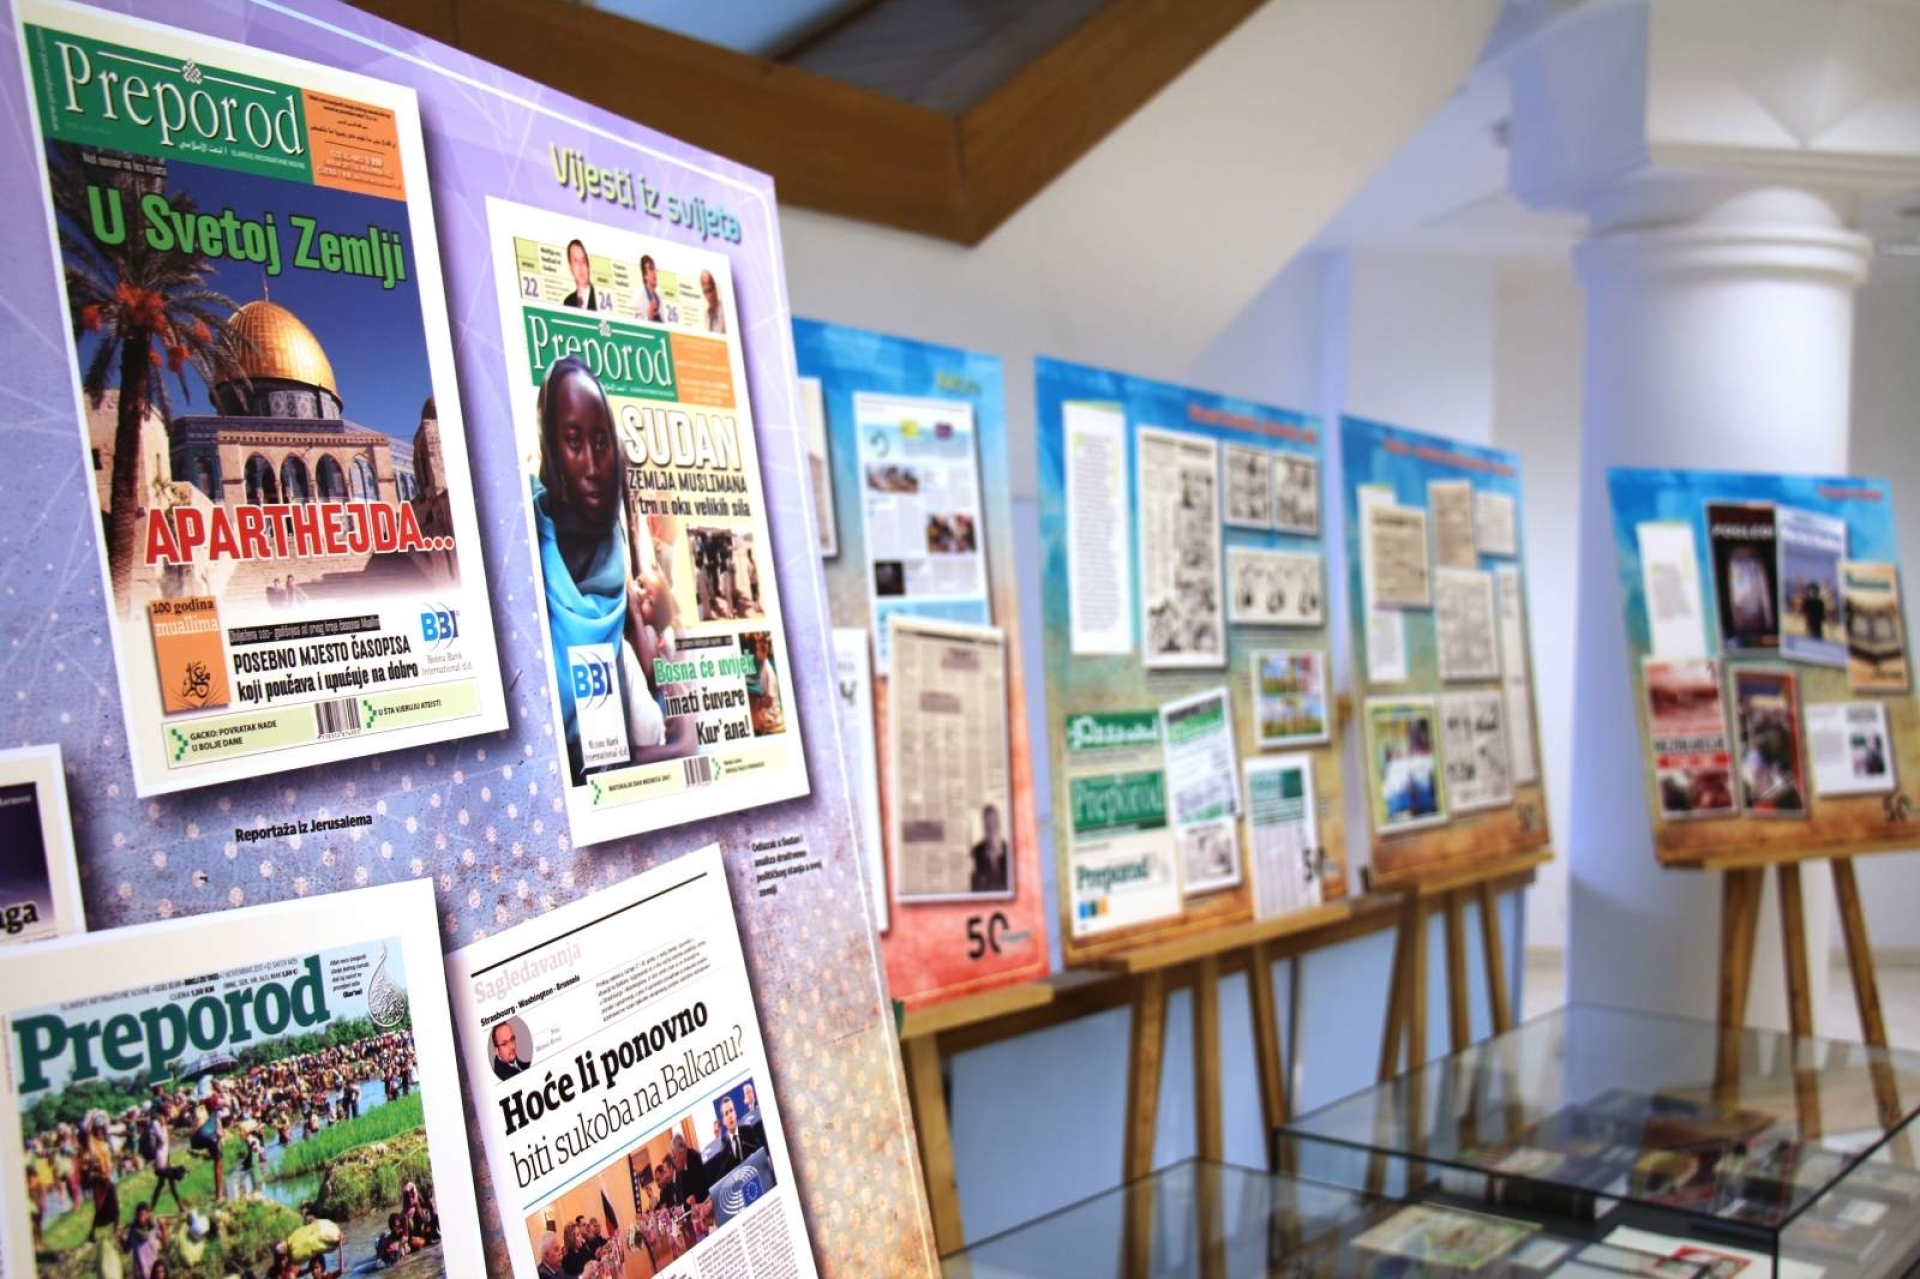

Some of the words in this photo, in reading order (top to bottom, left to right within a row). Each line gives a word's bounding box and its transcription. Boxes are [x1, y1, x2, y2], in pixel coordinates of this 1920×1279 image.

[54, 41, 305, 157] Preporod
[550, 143, 636, 211] Vijesti
[639, 175, 661, 219] iz
[666, 194, 743, 244] svijeta
[87, 185, 127, 246] U
[141, 192, 282, 277] Svetoj
[290, 214, 407, 289] Zemlji
[522, 276, 540, 298] 22
[598, 292, 614, 311] 24
[665, 305, 680, 323] 26
[621, 404, 743, 472] SUDAN
[629, 469, 678, 492] ZEMLJA
[677, 472, 749, 494] MUSLIMANA
[638, 496, 659, 516] trn
[660, 500, 669, 515] u
[671, 496, 693, 516] oku
[694, 497, 730, 517] velikih
[731, 498, 752, 517] sila
[144, 501, 456, 566] APARTHEJDA...
[152, 601, 172, 615] 100
[173, 598, 215, 616] godina
[154, 614, 219, 638] muallima
[420, 609, 460, 642] BBI
[233, 646, 297, 675] POSEBNO
[300, 641, 350, 667] MJESTO
[350, 634, 412, 661] ČASOPISA
[653, 657, 698, 686] Bosna
[700, 652, 716, 680] će
[718, 648, 758, 681] uvijek
[236, 679, 263, 705] koji
[265, 673, 317, 702] poučava
[317, 671, 323, 692] i
[324, 665, 370, 692] upućuje
[371, 666, 387, 682] na
[387, 659, 419, 680] dobro
[571, 660, 614, 700] BBI
[378, 708, 384, 716] U
[665, 690, 701, 717] imati
[702, 685, 746, 712] čuvare
[191, 743, 199, 753] U
[198, 739, 223, 752] BOLJE
[222, 736, 243, 748] DANE
[218, 723, 258, 737] POVRATAK
[257, 719, 278, 730] NADE
[234, 822, 297, 843] Reportaža
[310, 814, 374, 833] Jerusalema
[0, 901, 40, 934] ga
[473, 941, 583, 1005] Sagledavanja
[12, 954, 332, 1094] Preporod
[480, 1006, 516, 1027] Strasbourg
[517, 987, 554, 1009] Washington
[498, 1068, 577, 1136] Hoće
[574, 1050, 602, 1094] li
[599, 1000, 709, 1090] ponovno
[509, 1143, 554, 1190] biti
[554, 1095, 635, 1167] sukoba
[634, 1081, 664, 1110] na
[661, 1023, 745, 1093] Balkanu?
